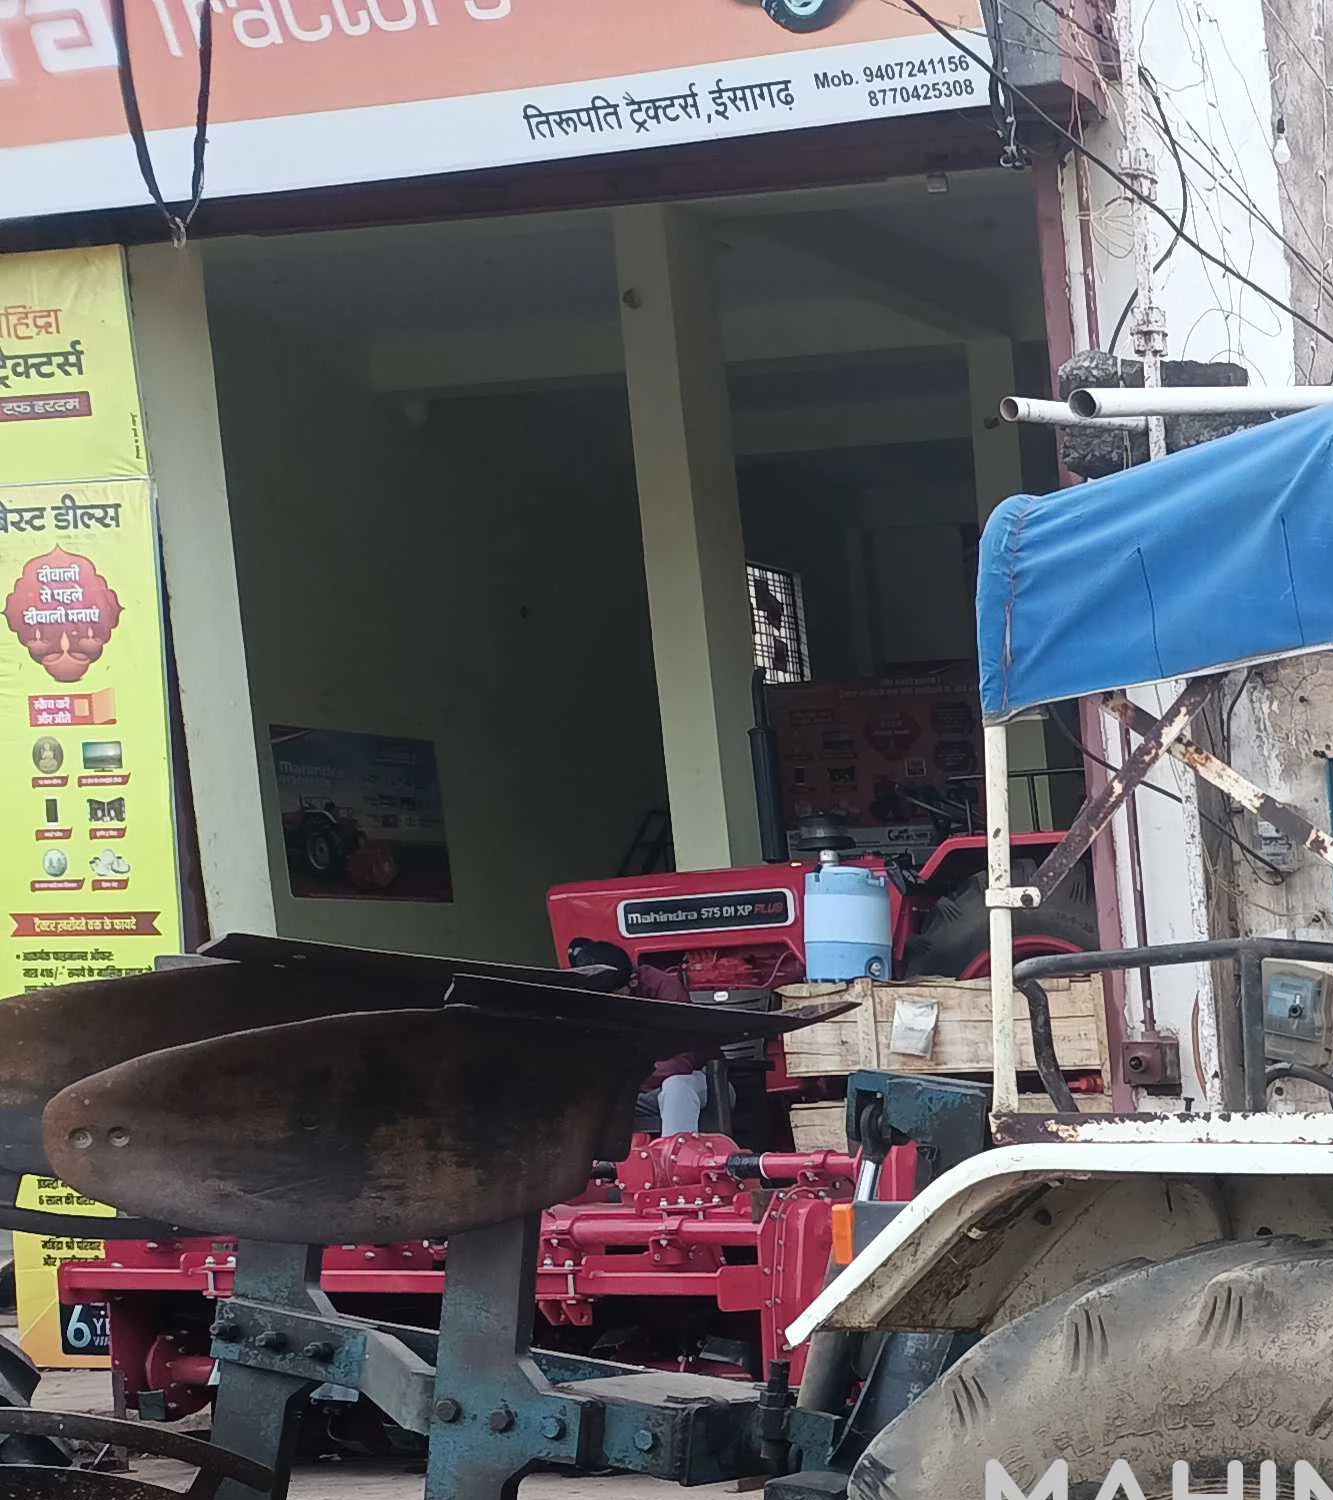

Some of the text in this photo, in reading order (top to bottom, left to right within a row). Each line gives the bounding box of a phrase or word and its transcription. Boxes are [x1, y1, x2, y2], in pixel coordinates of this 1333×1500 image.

[814, 54, 970, 91] Mob. 9407241156
[868, 78, 975, 108] 8770425308
[51, 493, 122, 531] डील्स
[40, 586, 83, 605] से पहले
[701, 906, 720, 919] 575
[723, 905, 735, 917] DI
[737, 904, 752, 916] XP
[67, 1304, 91, 1348] 6
